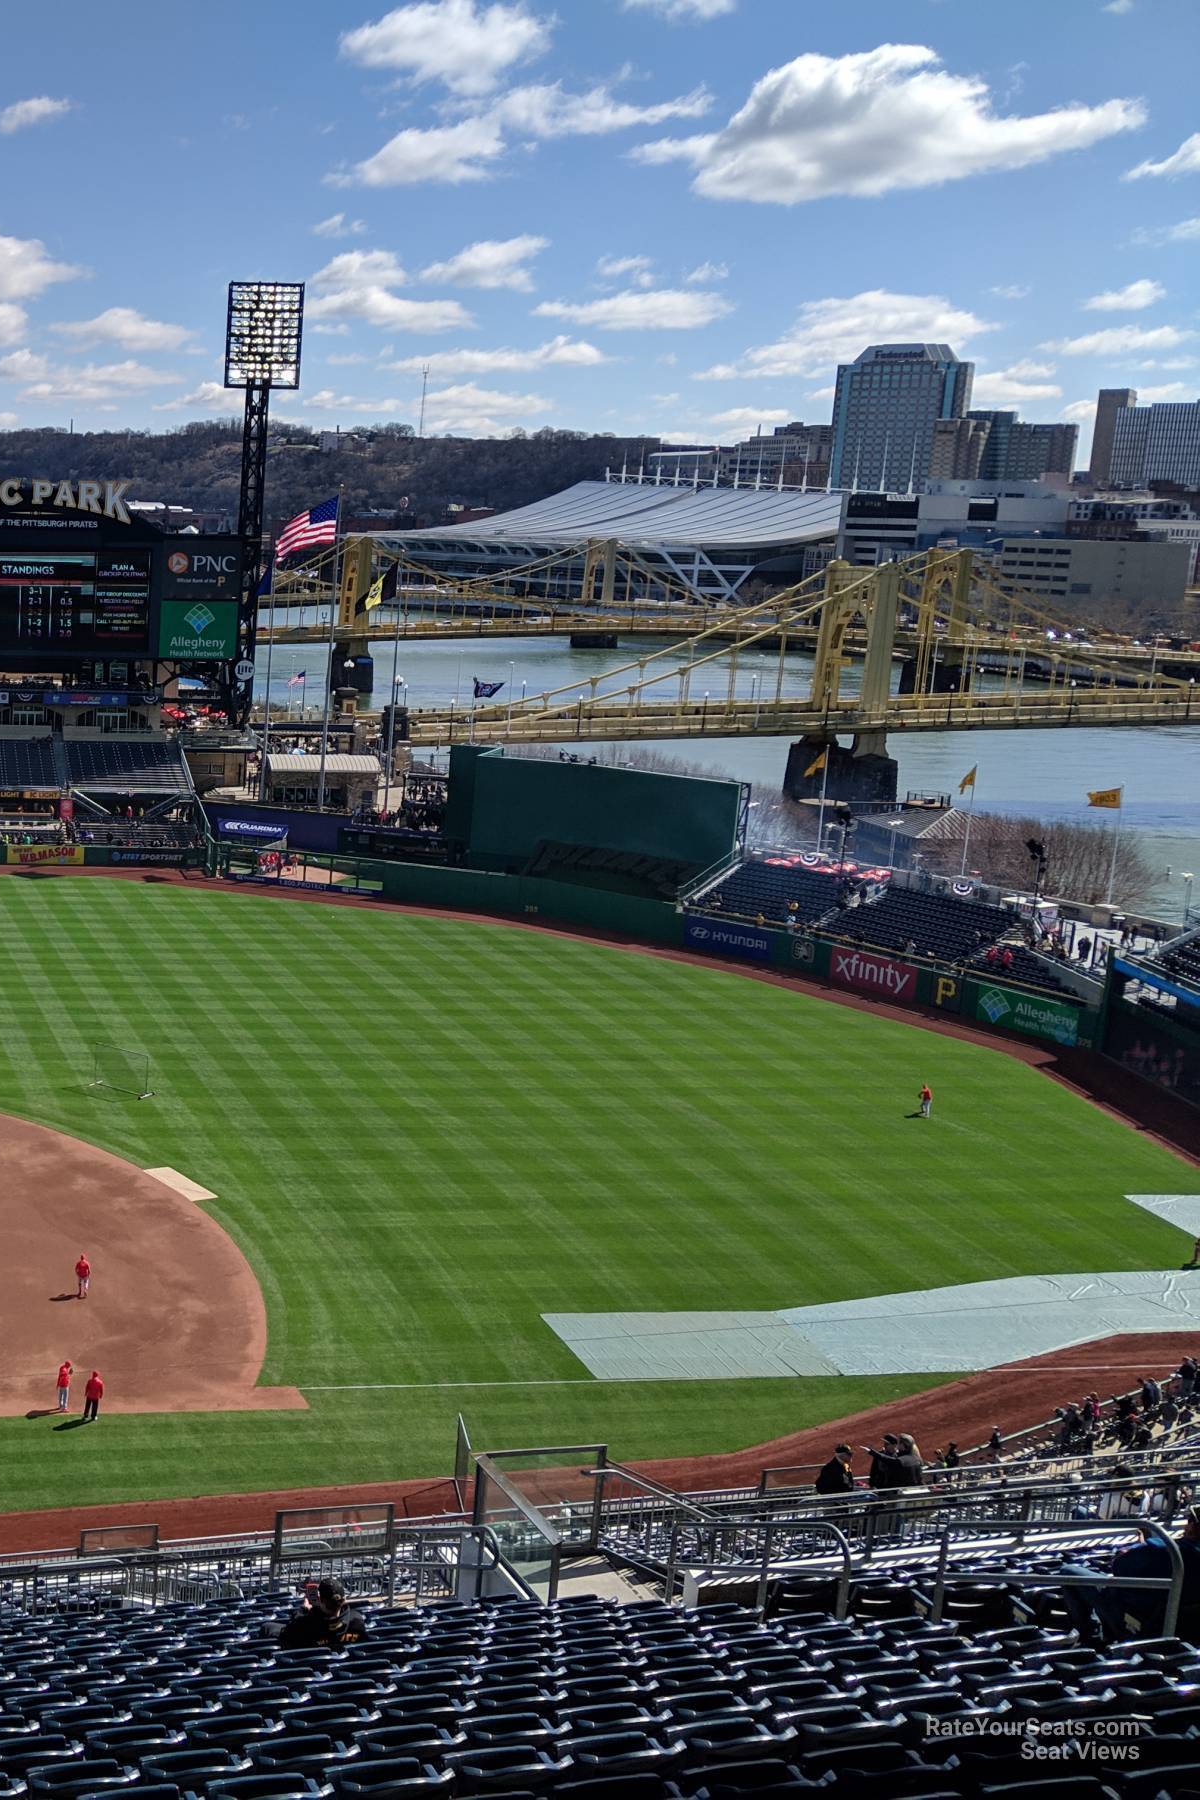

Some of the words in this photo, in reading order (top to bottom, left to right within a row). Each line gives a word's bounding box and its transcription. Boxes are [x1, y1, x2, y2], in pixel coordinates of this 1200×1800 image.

[875, 350, 925, 358] Federated
[31, 479, 134, 524] PARK
[22, 519, 67, 527] PITTSBURGH
[69, 520, 98, 528] PIRATES
[192, 555, 236, 572] PNC
[1, 566, 55, 575] STANDINGS
[29, 587, 43, 595] 3-1
[60, 598, 73, 606] 0.5
[28, 618, 42, 626] 1-2
[60, 619, 72, 627] 1.5
[170, 636, 226, 650] Allegheny
[240, 822, 284, 833] GUARDIAN
[712, 931, 767, 950] HYUNDAI
[836, 954, 911, 994] xfinity
[935, 977, 957, 1007] P
[1015, 1002, 1077, 1031] Allegheny
[1014, 1016, 1040, 1033] Health
